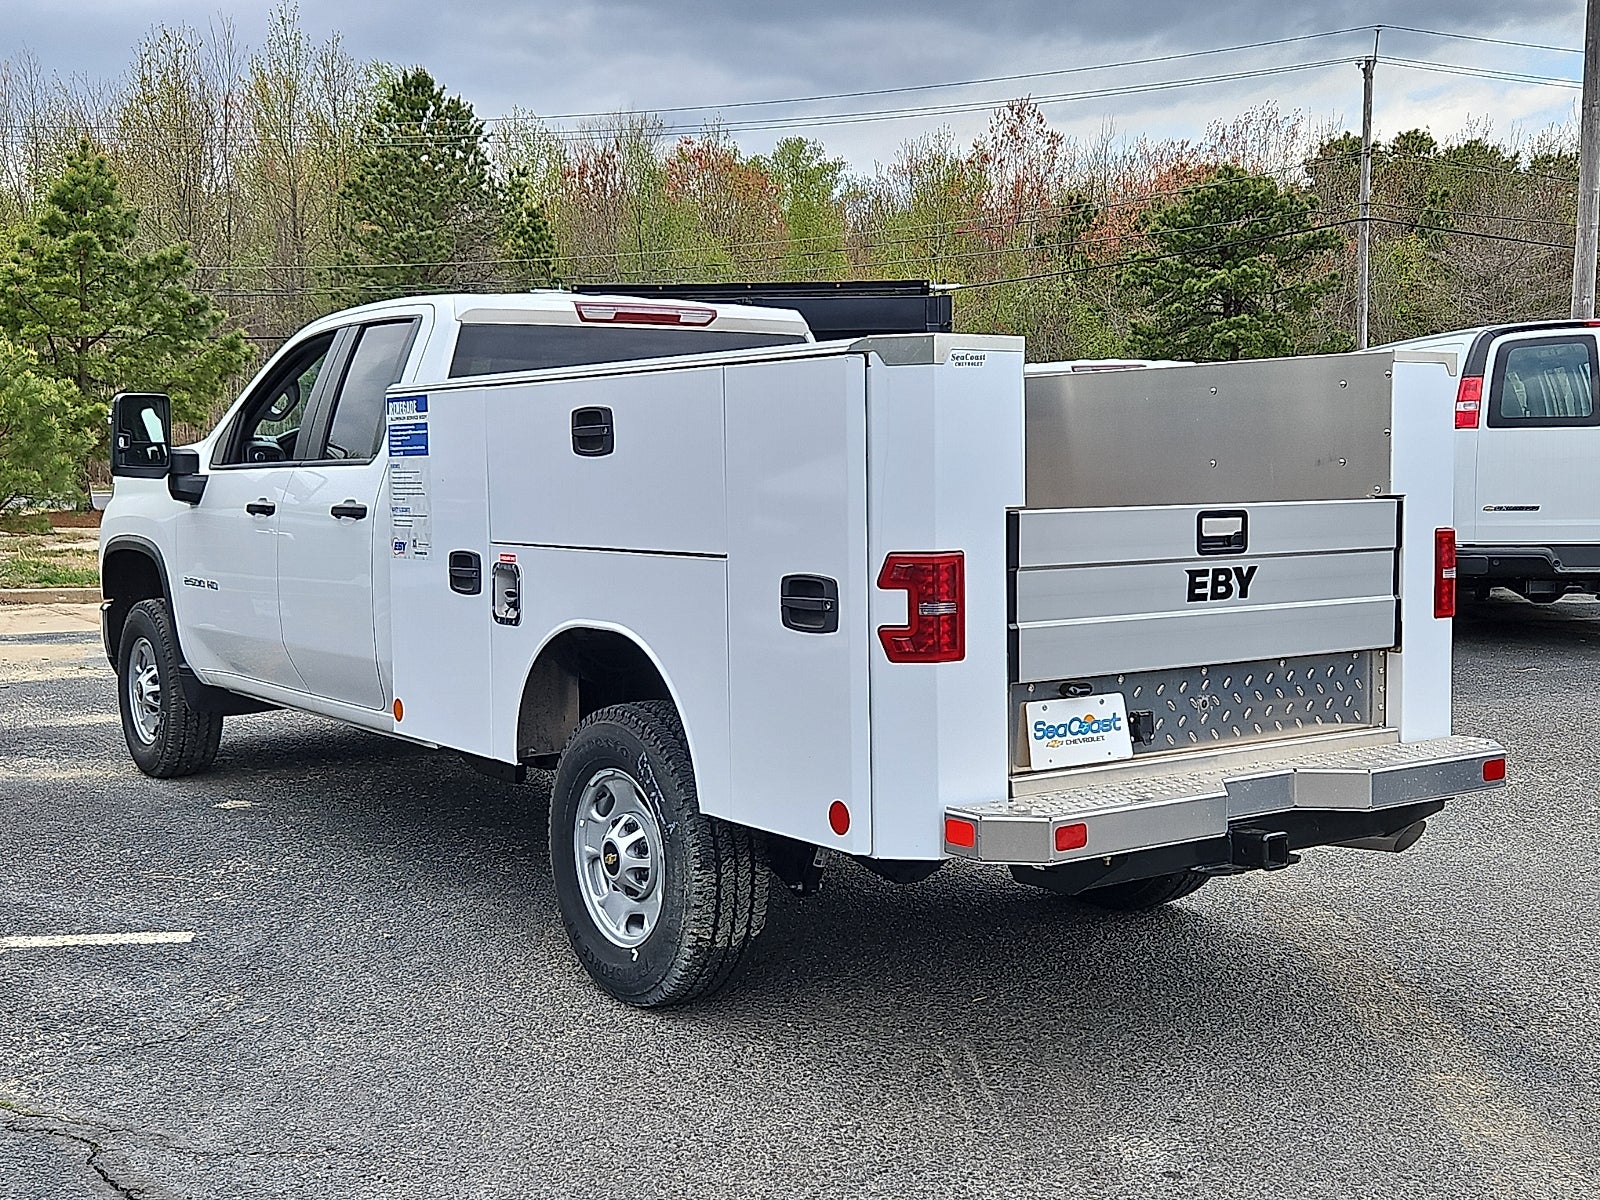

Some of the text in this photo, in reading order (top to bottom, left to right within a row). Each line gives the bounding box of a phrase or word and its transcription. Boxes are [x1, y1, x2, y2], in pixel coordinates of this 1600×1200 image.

[951, 353, 986, 361] SeaCoast
[184, 576, 219, 590] 2500 HD
[1184, 565, 1259, 602] EBY
[1034, 712, 1122, 740] SeaCoast
[1065, 735, 1106, 746] CHEVROLET
